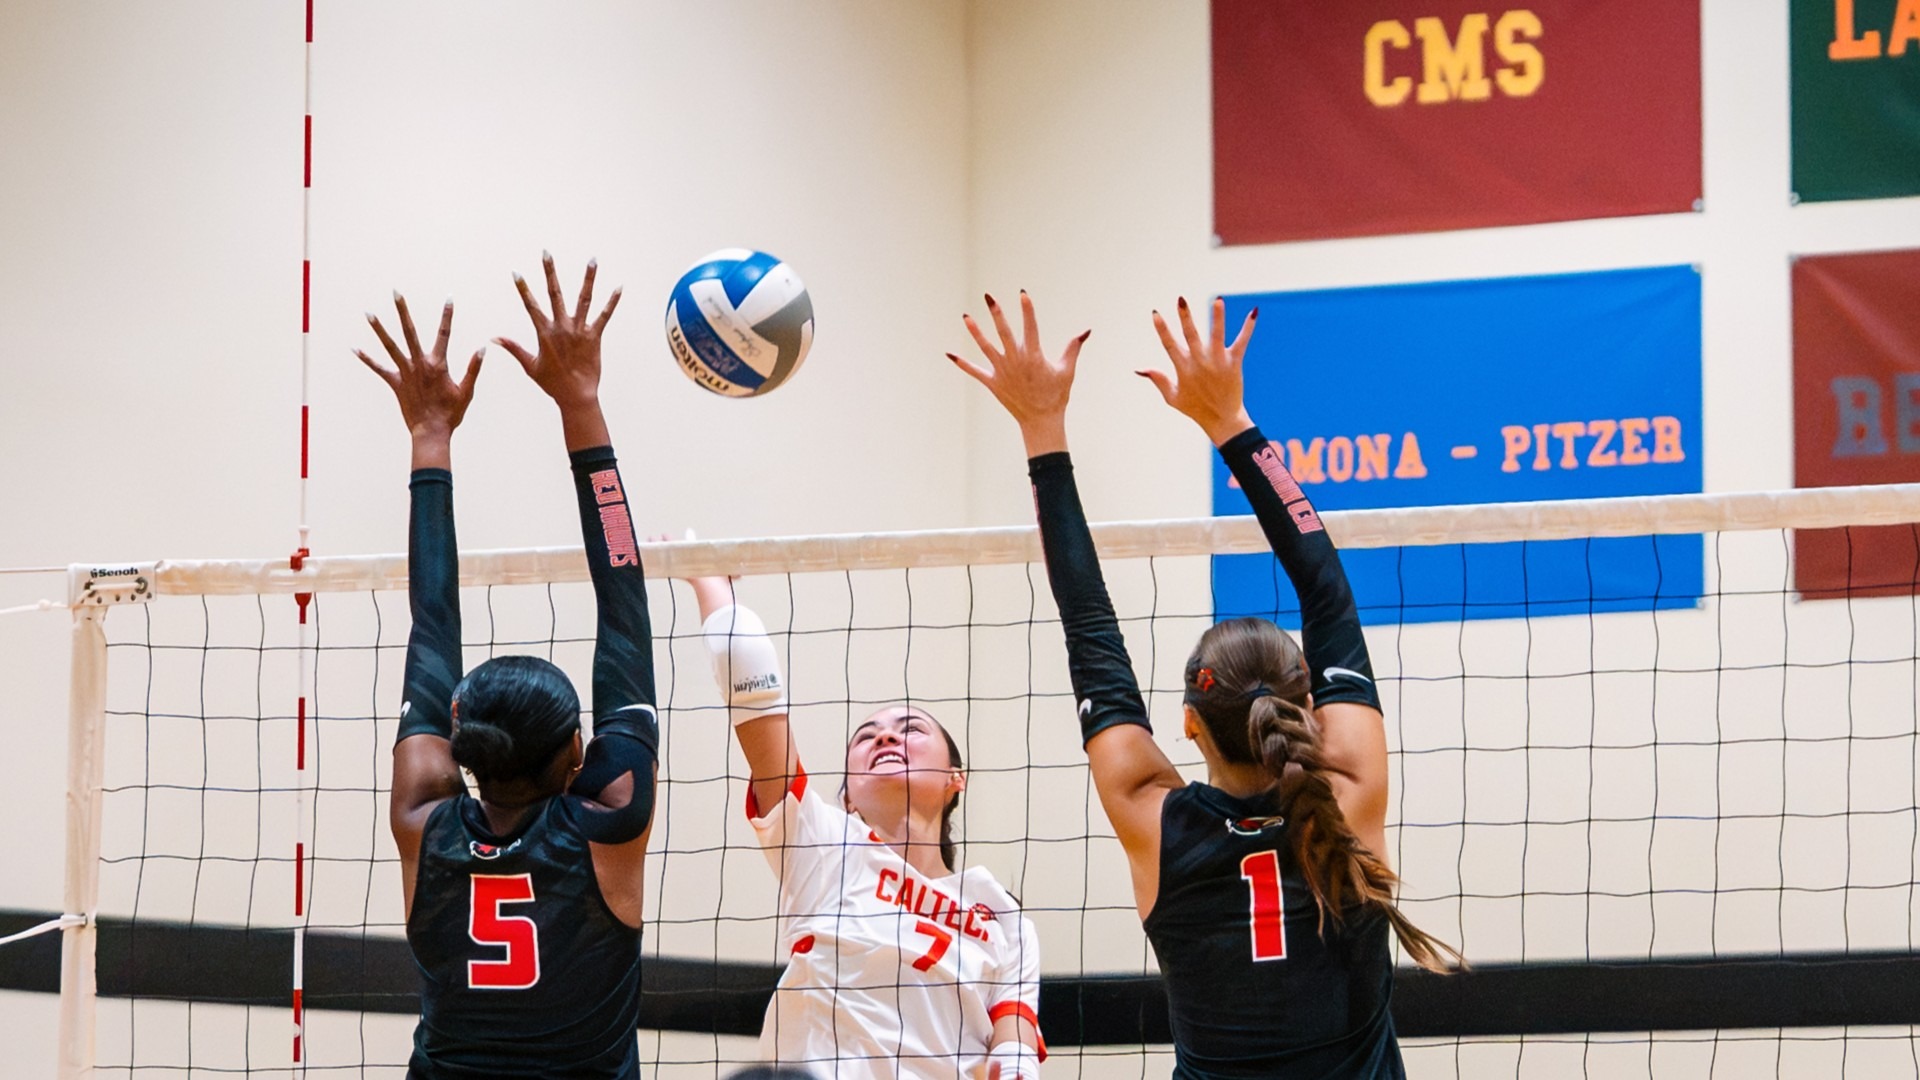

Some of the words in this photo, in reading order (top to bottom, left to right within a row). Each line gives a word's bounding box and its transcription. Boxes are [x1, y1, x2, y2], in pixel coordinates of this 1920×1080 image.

[1364, 9, 1544, 107] CMS
[670, 326, 730, 392] molten
[1227, 431, 1428, 489] MONA
[1501, 416, 1686, 472] PITZER
[589, 468, 625, 505] RED
[1287, 499, 1324, 534] RED
[98, 566, 139, 578] Senoh
[468, 872, 541, 989] 5
[1240, 849, 1287, 962] 1
[912, 920, 953, 972] 7
